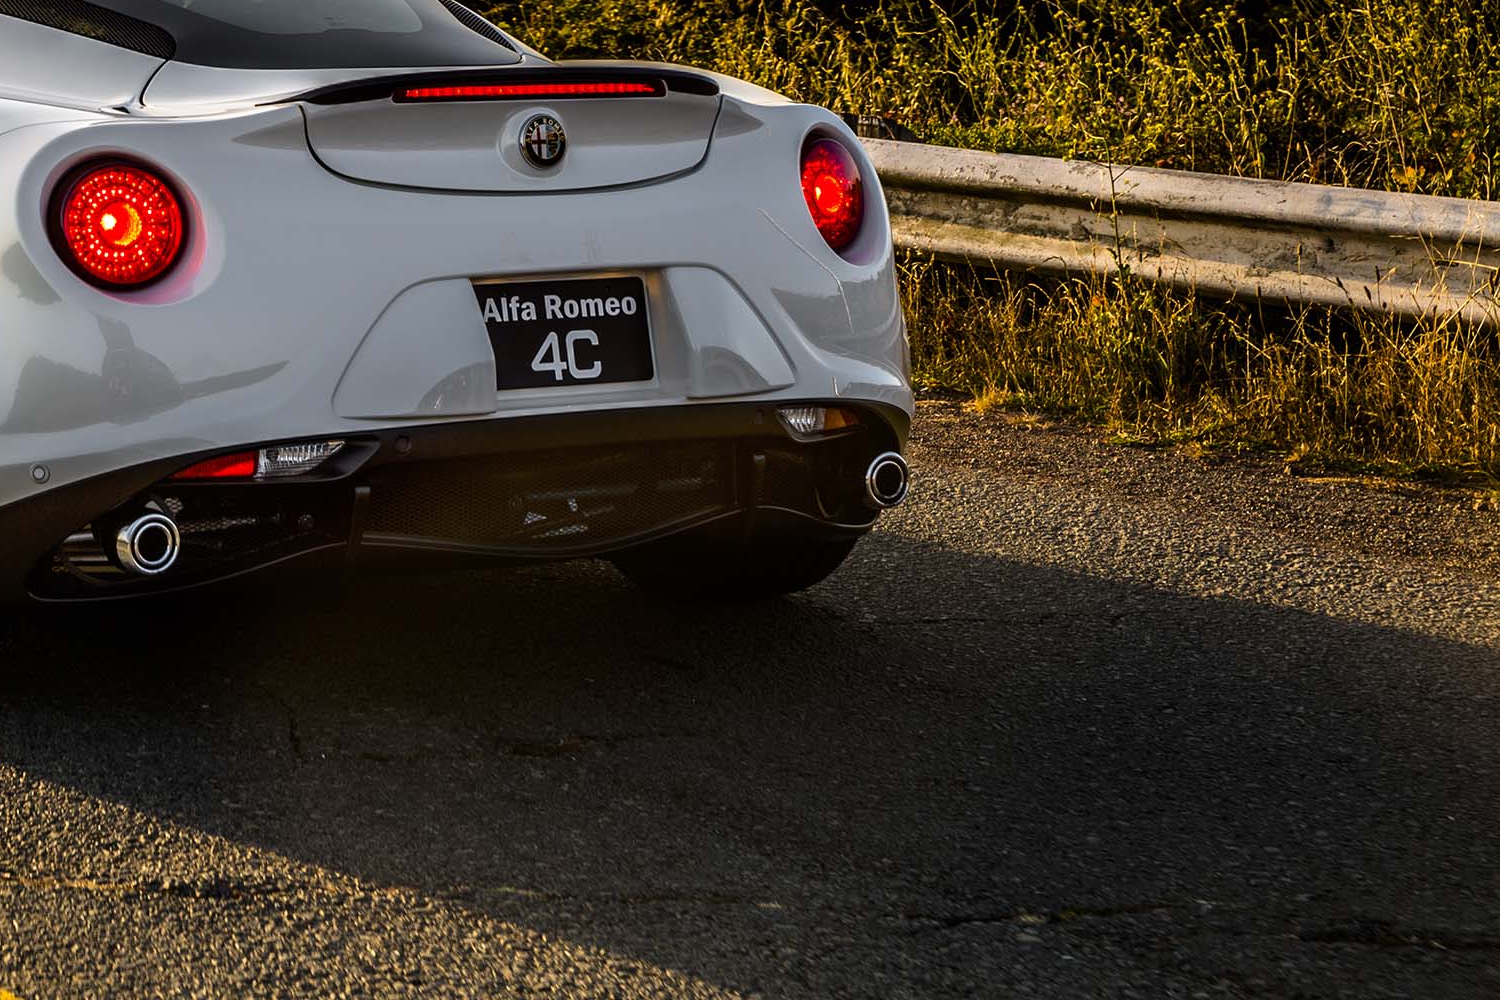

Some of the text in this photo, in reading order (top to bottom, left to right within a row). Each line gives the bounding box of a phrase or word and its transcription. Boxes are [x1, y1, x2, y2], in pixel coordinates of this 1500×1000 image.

[483, 294, 637, 323] Alfa Romeo
[531, 329, 602, 381] 4C
